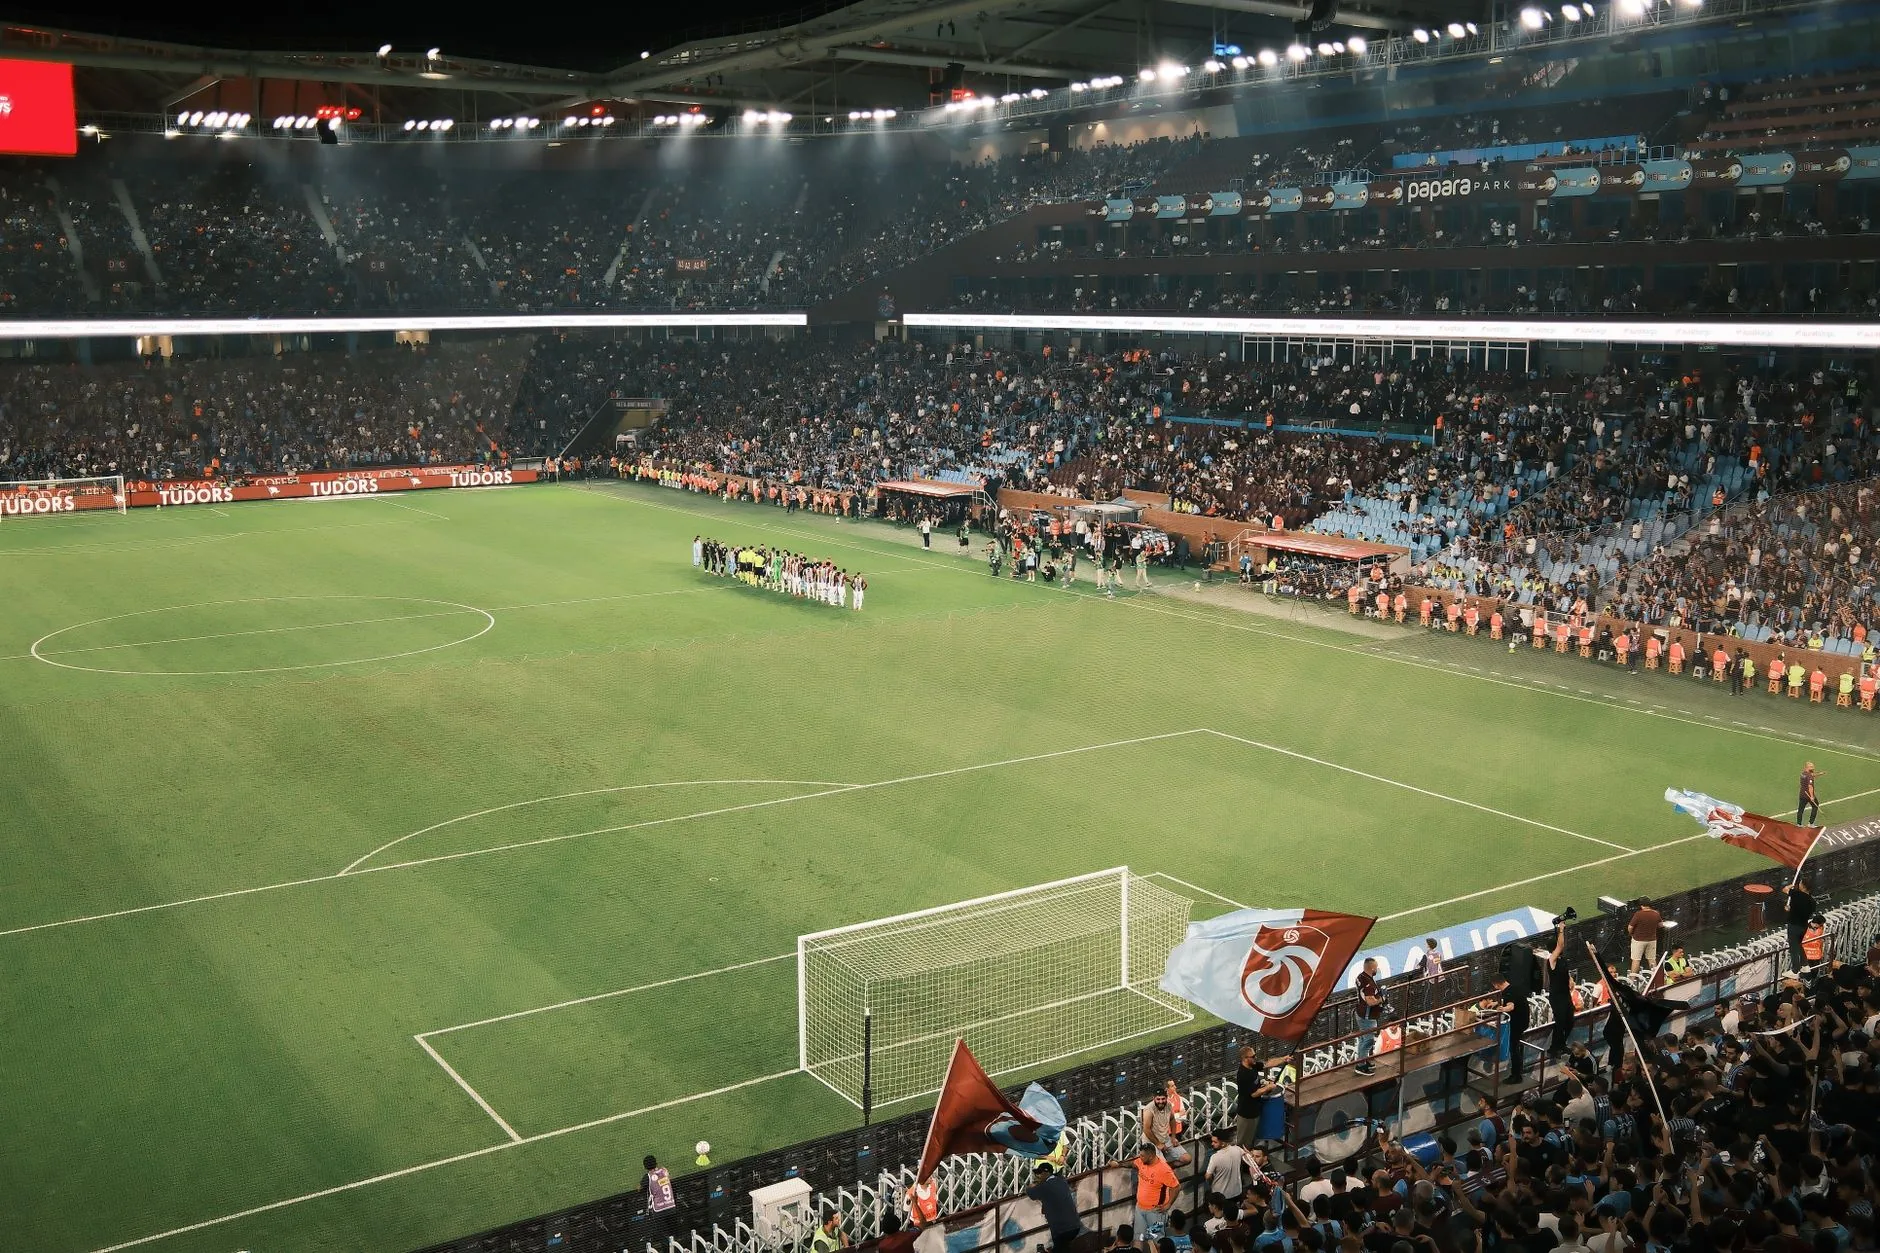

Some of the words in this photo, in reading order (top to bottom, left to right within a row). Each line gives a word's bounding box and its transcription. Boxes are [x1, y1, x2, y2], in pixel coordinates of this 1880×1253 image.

[1407, 178, 1471, 203] papara
[1474, 180, 1511, 191] PARK
[310, 478, 379, 497] TUDORS
[450, 470, 513, 488] TUDORS
[159, 487, 234, 506] TUDORS
[1821, 819, 1880, 846] EKTRİK
